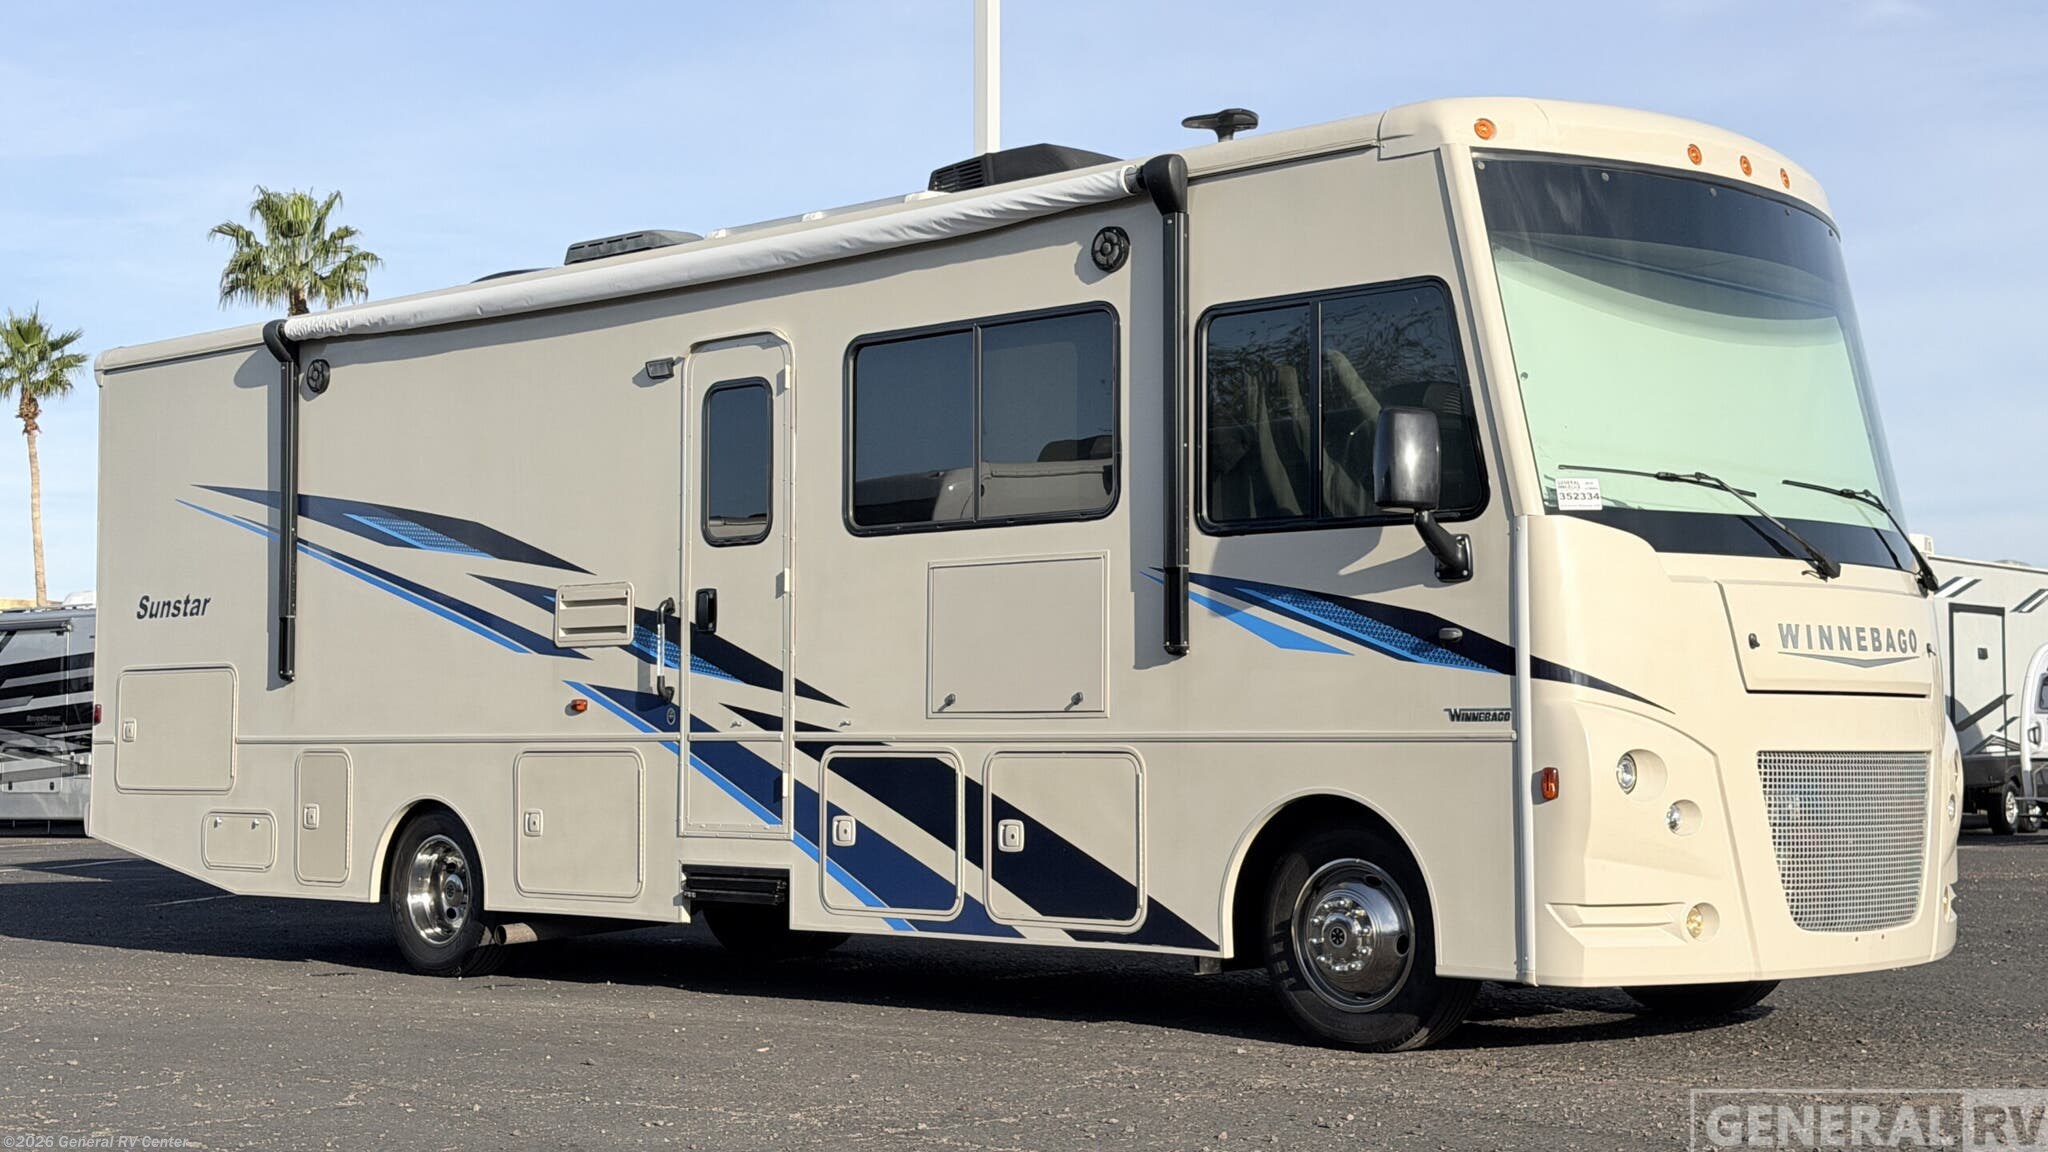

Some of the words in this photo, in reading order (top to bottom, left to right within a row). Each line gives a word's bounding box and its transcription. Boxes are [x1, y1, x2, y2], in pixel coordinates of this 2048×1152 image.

[1559, 492, 1600, 501] 352334
[136, 594, 211, 620] Sunstar
[1777, 623, 1918, 654] WINNEBAGO
[1444, 707, 1512, 722] WINNEBAGO
